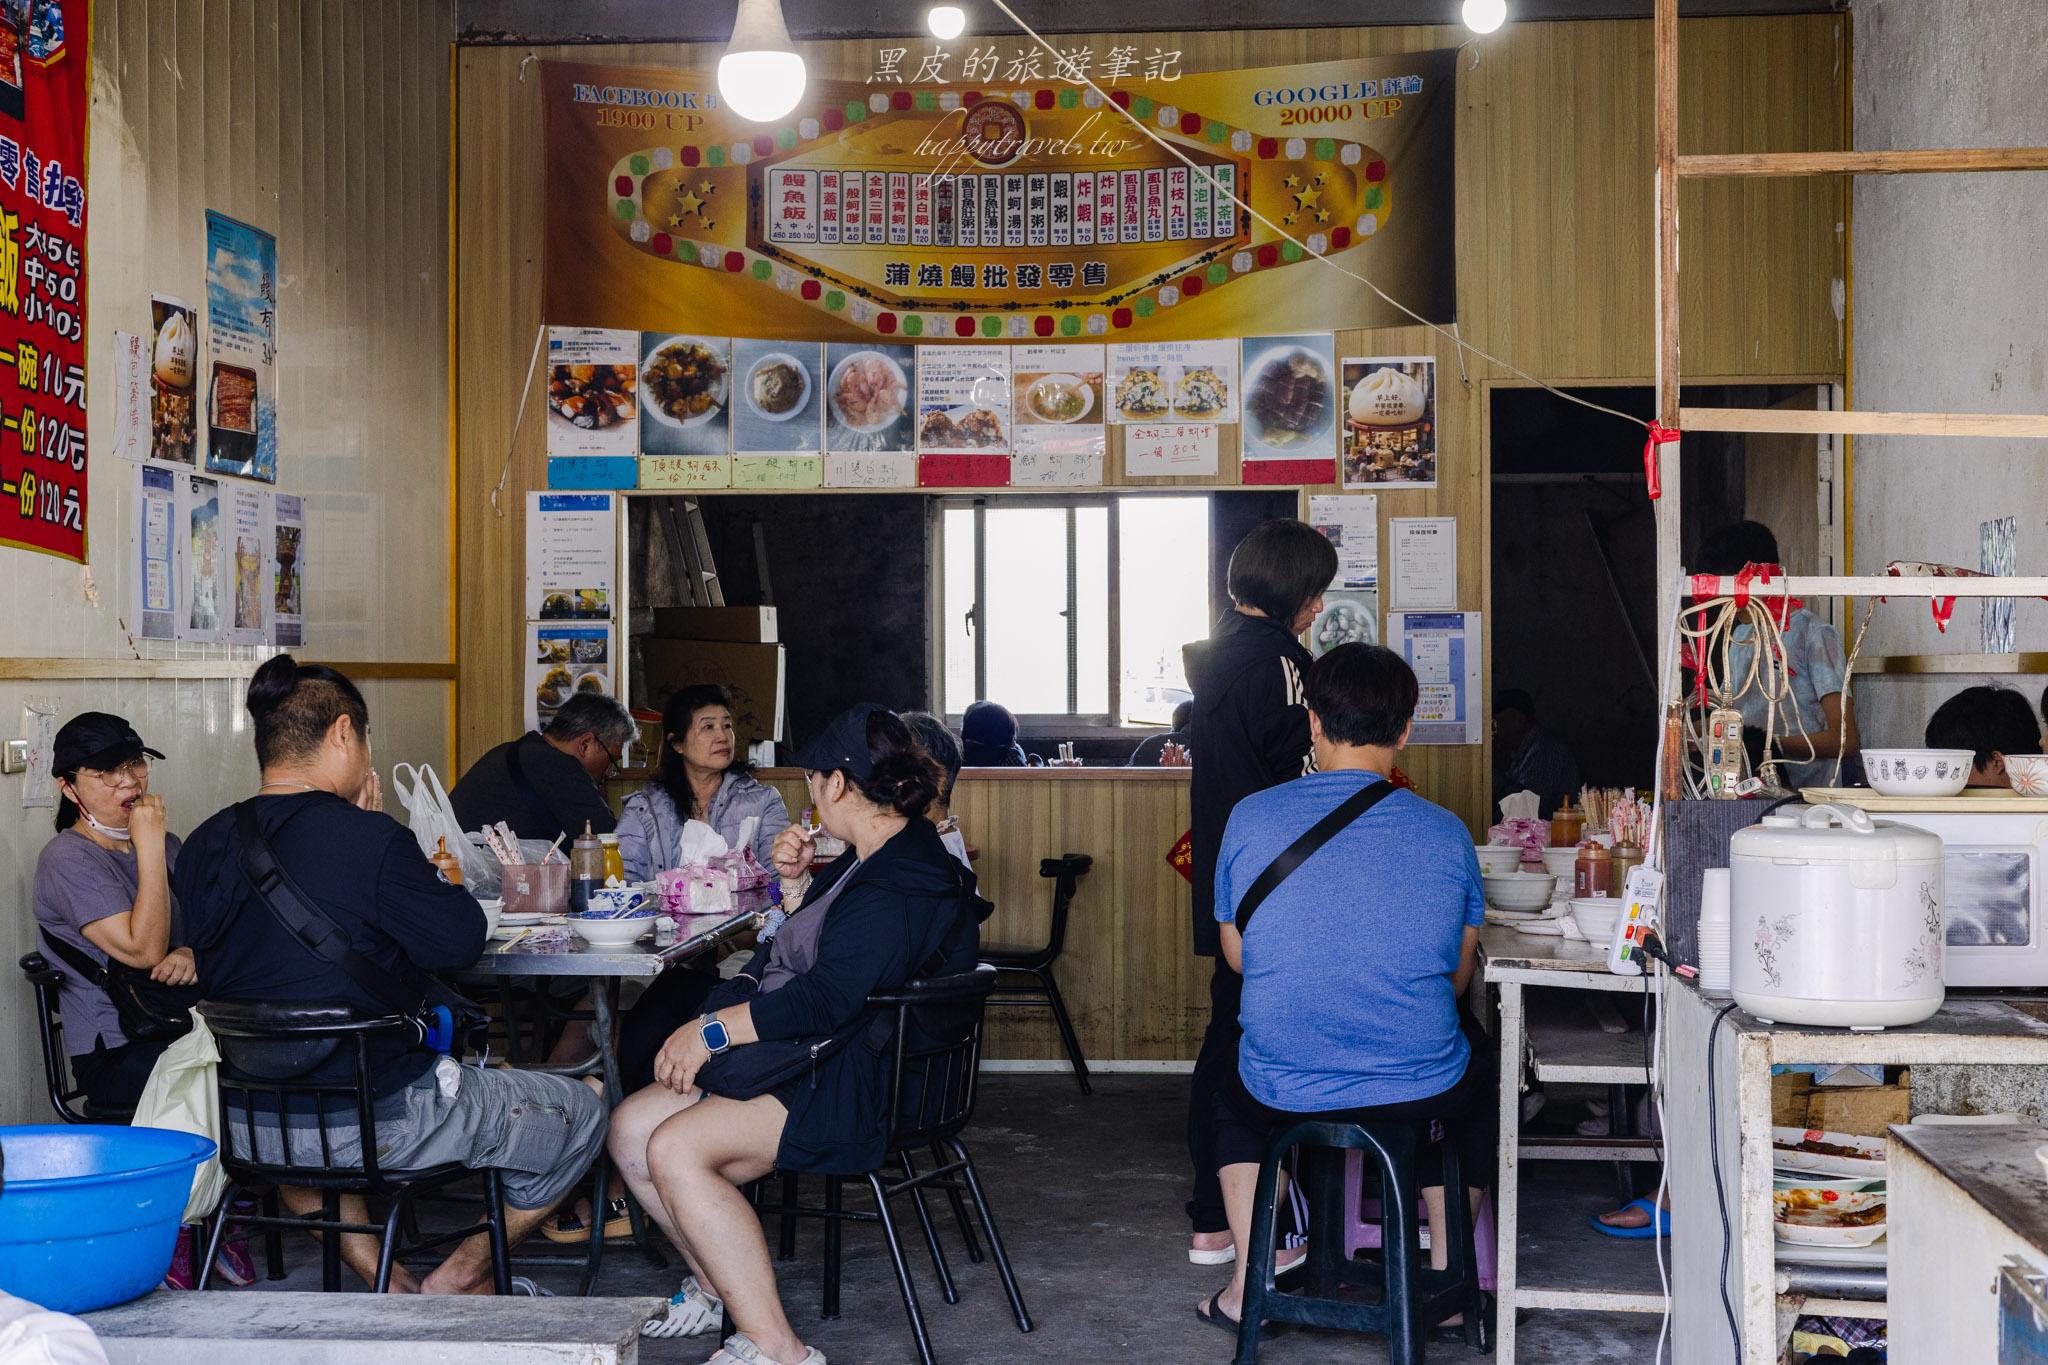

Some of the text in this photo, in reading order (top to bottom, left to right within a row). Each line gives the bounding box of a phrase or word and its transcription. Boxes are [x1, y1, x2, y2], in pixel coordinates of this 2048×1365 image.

[574, 84, 698, 111] FACEBOOK
[1254, 75, 1424, 106] GOOGLE 評論
[597, 108, 704, 132] 1900 UP
[1281, 99, 1402, 126] 20000 UP
[783, 173, 806, 220] 鰻魚飯
[961, 178, 975, 229] 虱目魚肚粥
[984, 178, 998, 229] 虱目魚肚湯
[1007, 178, 1021, 229] 鮮蚵湯
[1031, 177, 1045, 228] 鮮蚵粥
[1053, 179, 1068, 223] 蝦粥
[1077, 178, 1092, 223] 炸蝦
[1100, 175, 1115, 226] 炸蚵酥
[1147, 172, 1162, 219] 虱目魚丸
[1170, 171, 1185, 217] 花枝丸
[803, 232, 815, 240] 100
[847, 233, 859, 241] 40
[893, 234, 906, 242] 120
[916, 235, 929, 243] 120
[963, 236, 975, 244] 70
[986, 236, 998, 244] 70
[1056, 235, 1067, 243] 70
[1101, 233, 1114, 241] 70
[1125, 232, 1138, 240] 50
[1148, 231, 1161, 239] 50
[1171, 229, 1184, 237] 50
[1195, 228, 1208, 236] 30
[1219, 227, 1231, 235] 30
[885, 262, 1108, 288] 蒲燒鰻批發零售
